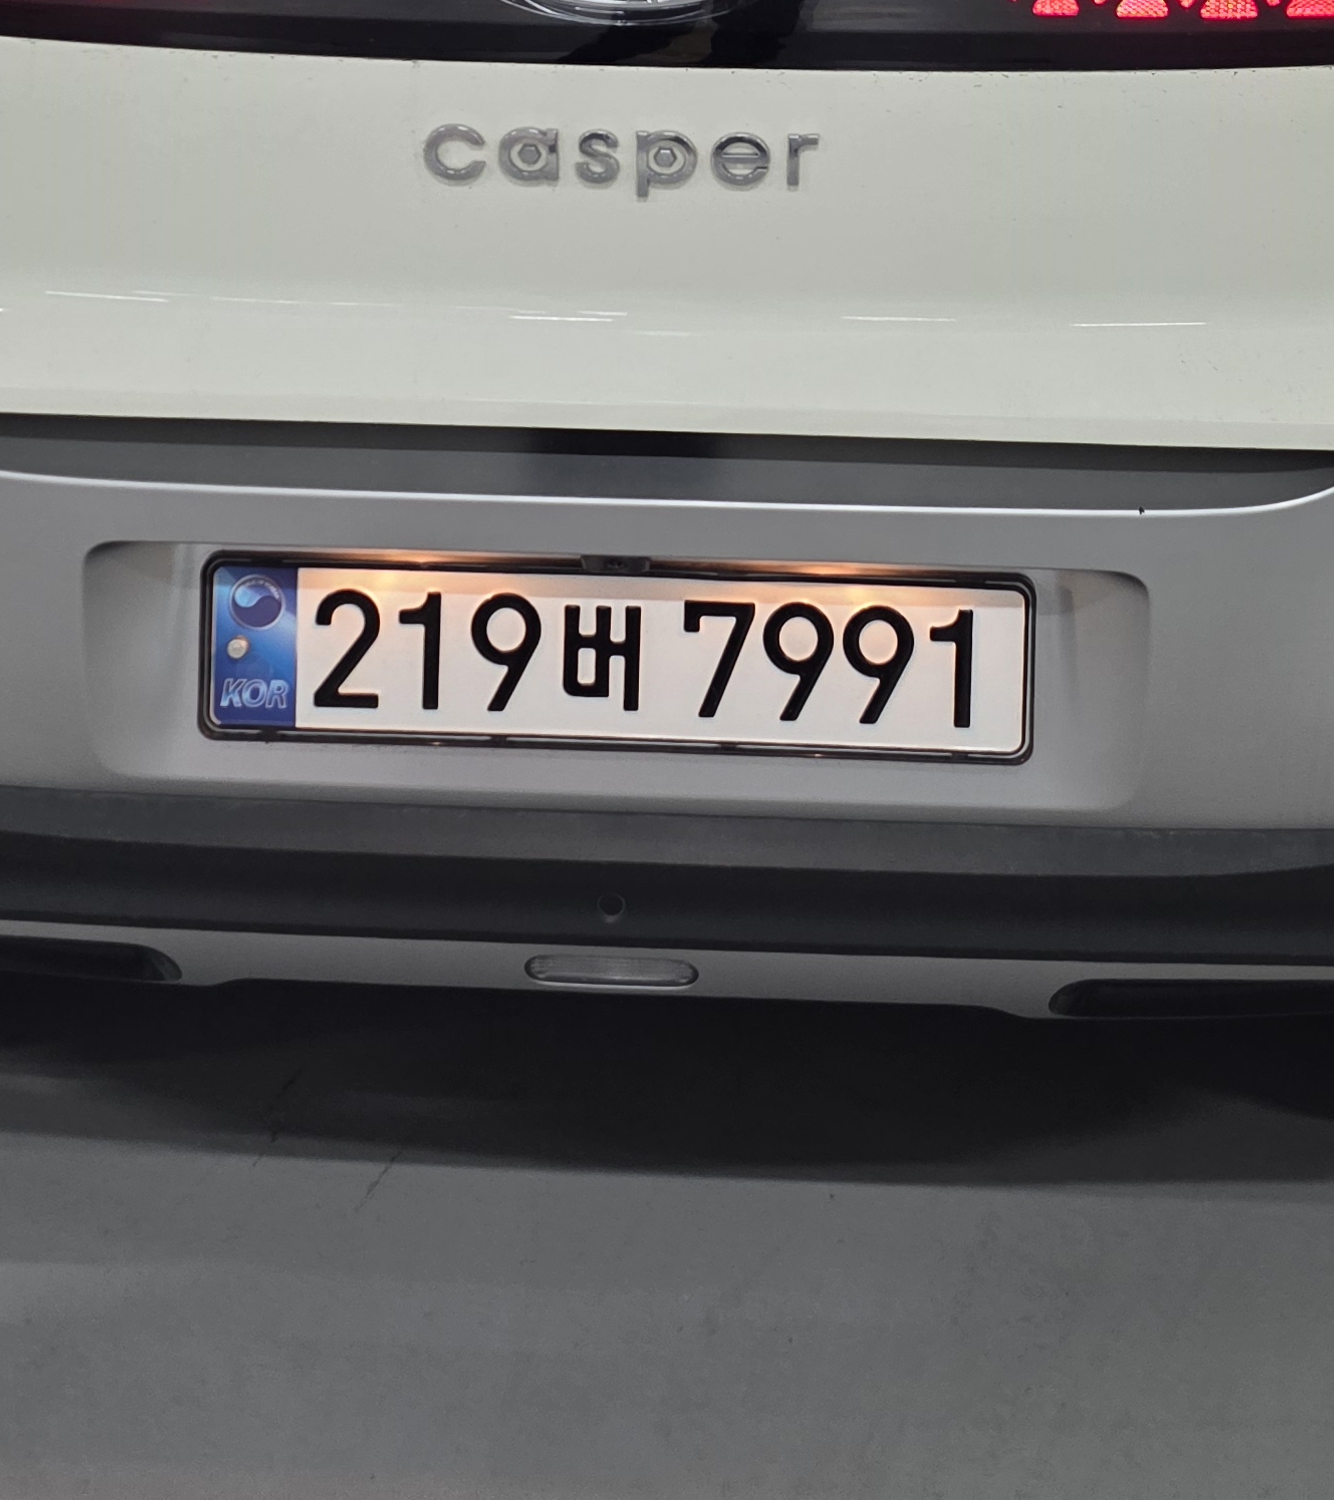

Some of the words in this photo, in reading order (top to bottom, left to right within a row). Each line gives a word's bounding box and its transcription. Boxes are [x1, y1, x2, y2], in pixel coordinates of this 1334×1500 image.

[423, 124, 820, 202] casper
[219, 677, 290, 709] KOR
[312, 588, 642, 713] 219버
[683, 600, 974, 730] 7991
